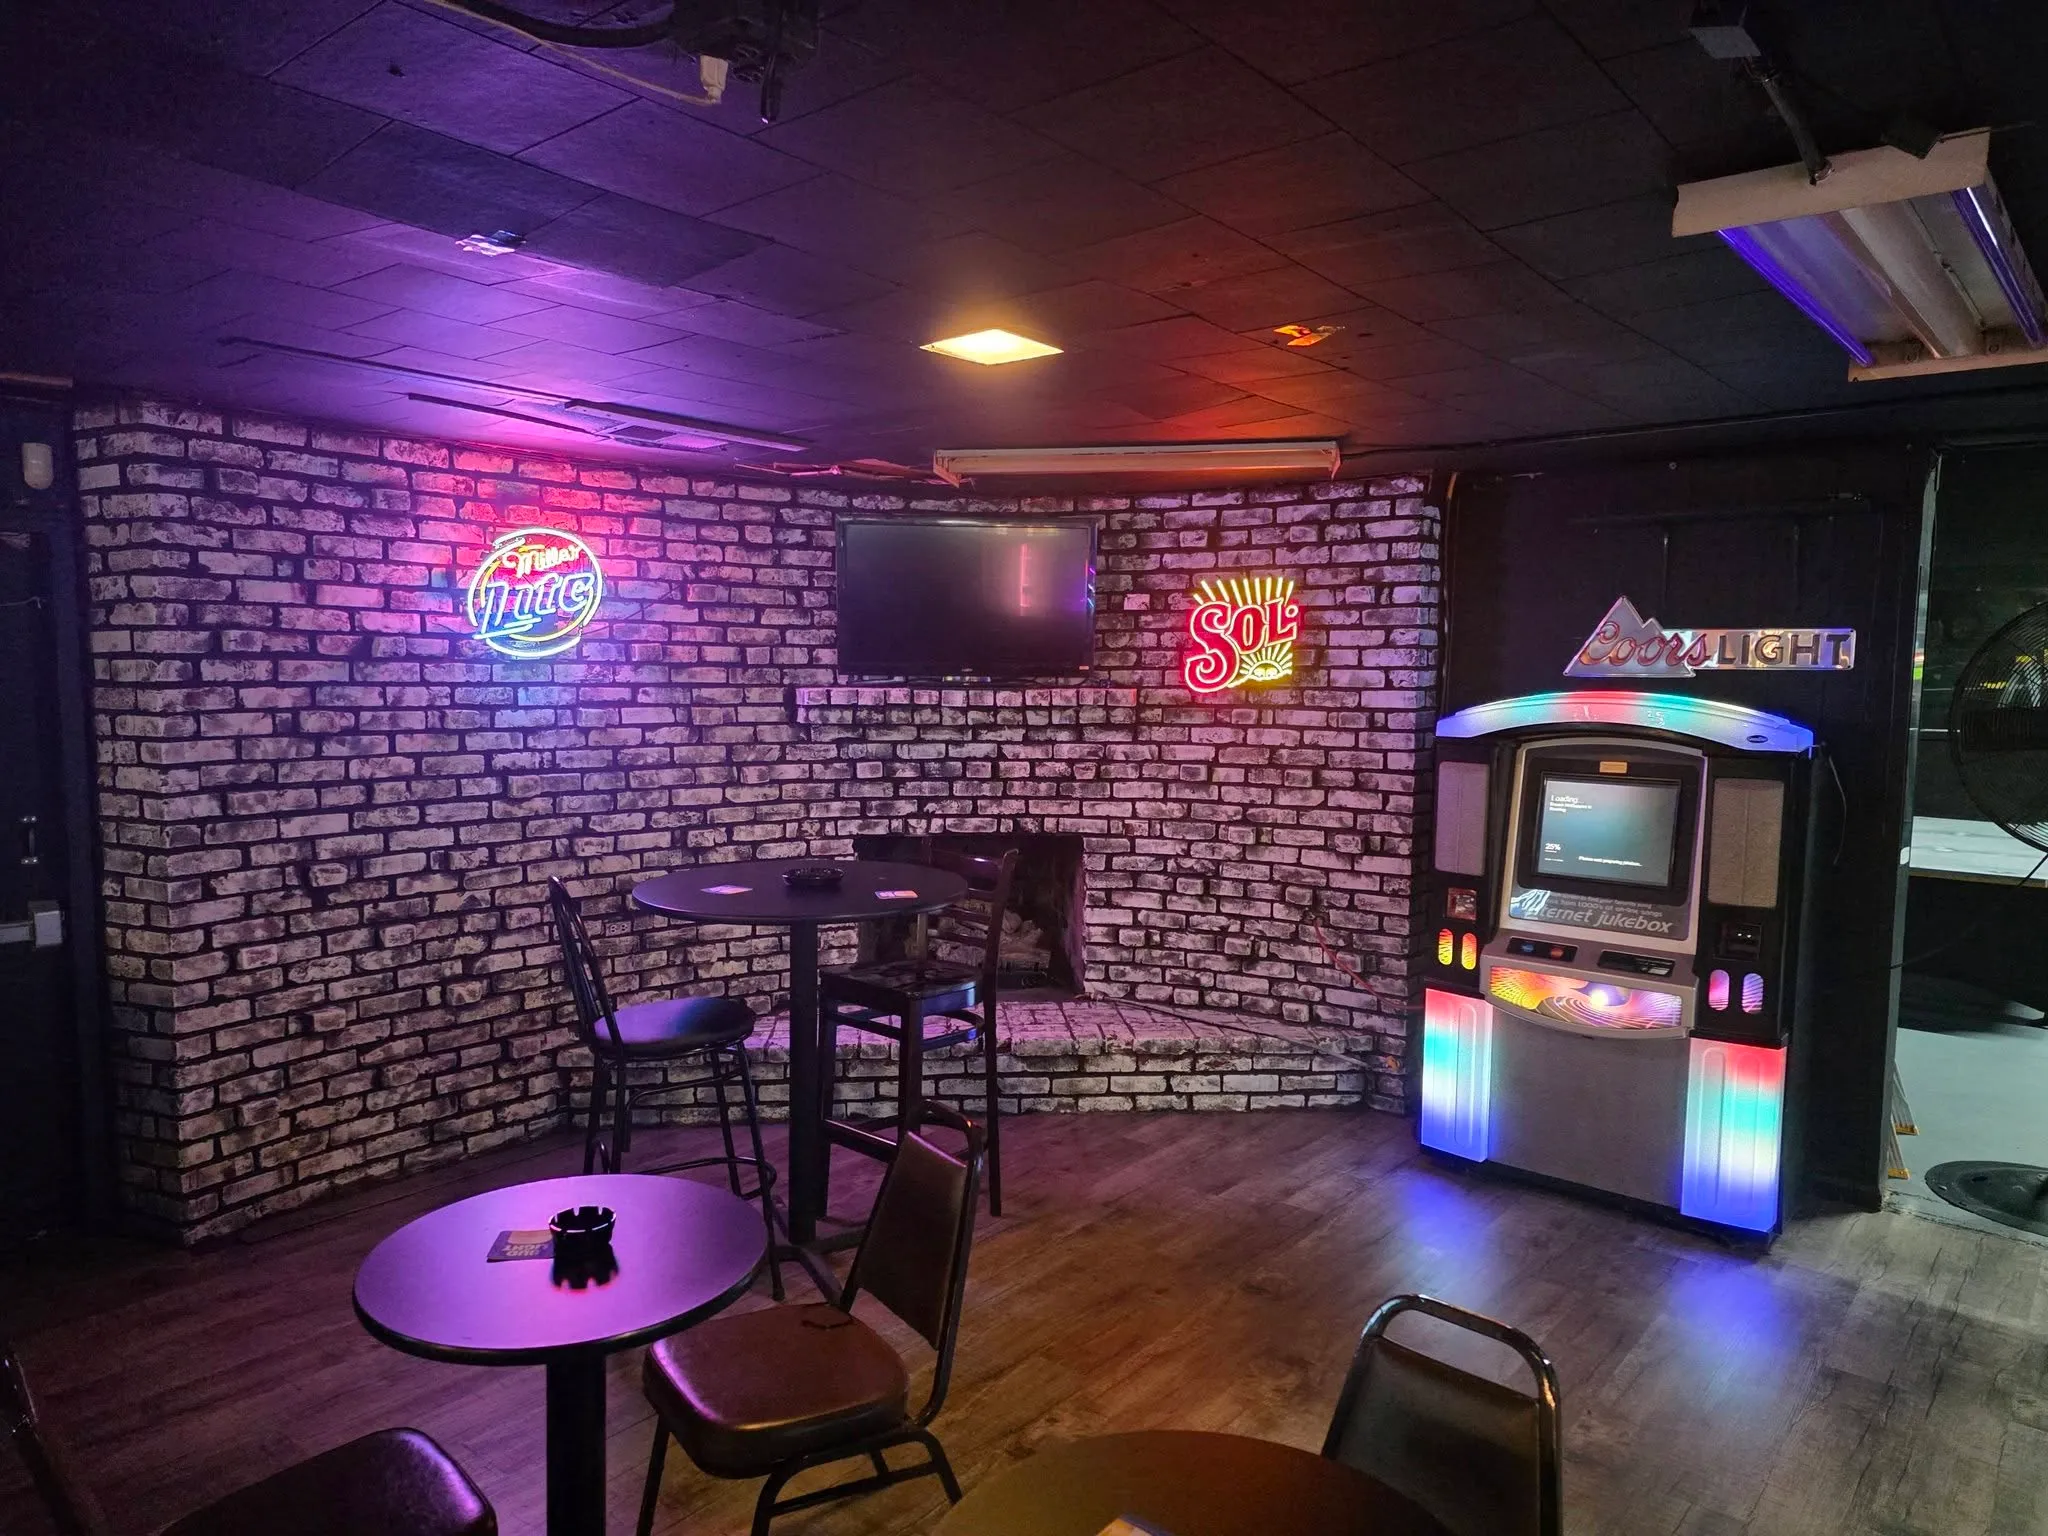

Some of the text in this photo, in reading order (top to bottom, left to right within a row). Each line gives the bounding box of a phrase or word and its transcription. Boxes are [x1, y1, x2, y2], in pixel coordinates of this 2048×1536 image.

[502, 544, 582, 578] Miller
[473, 572, 595, 639] Lite
[1579, 620, 1851, 667] Coors LIGHT
[1593, 911, 1673, 934] jukebox
